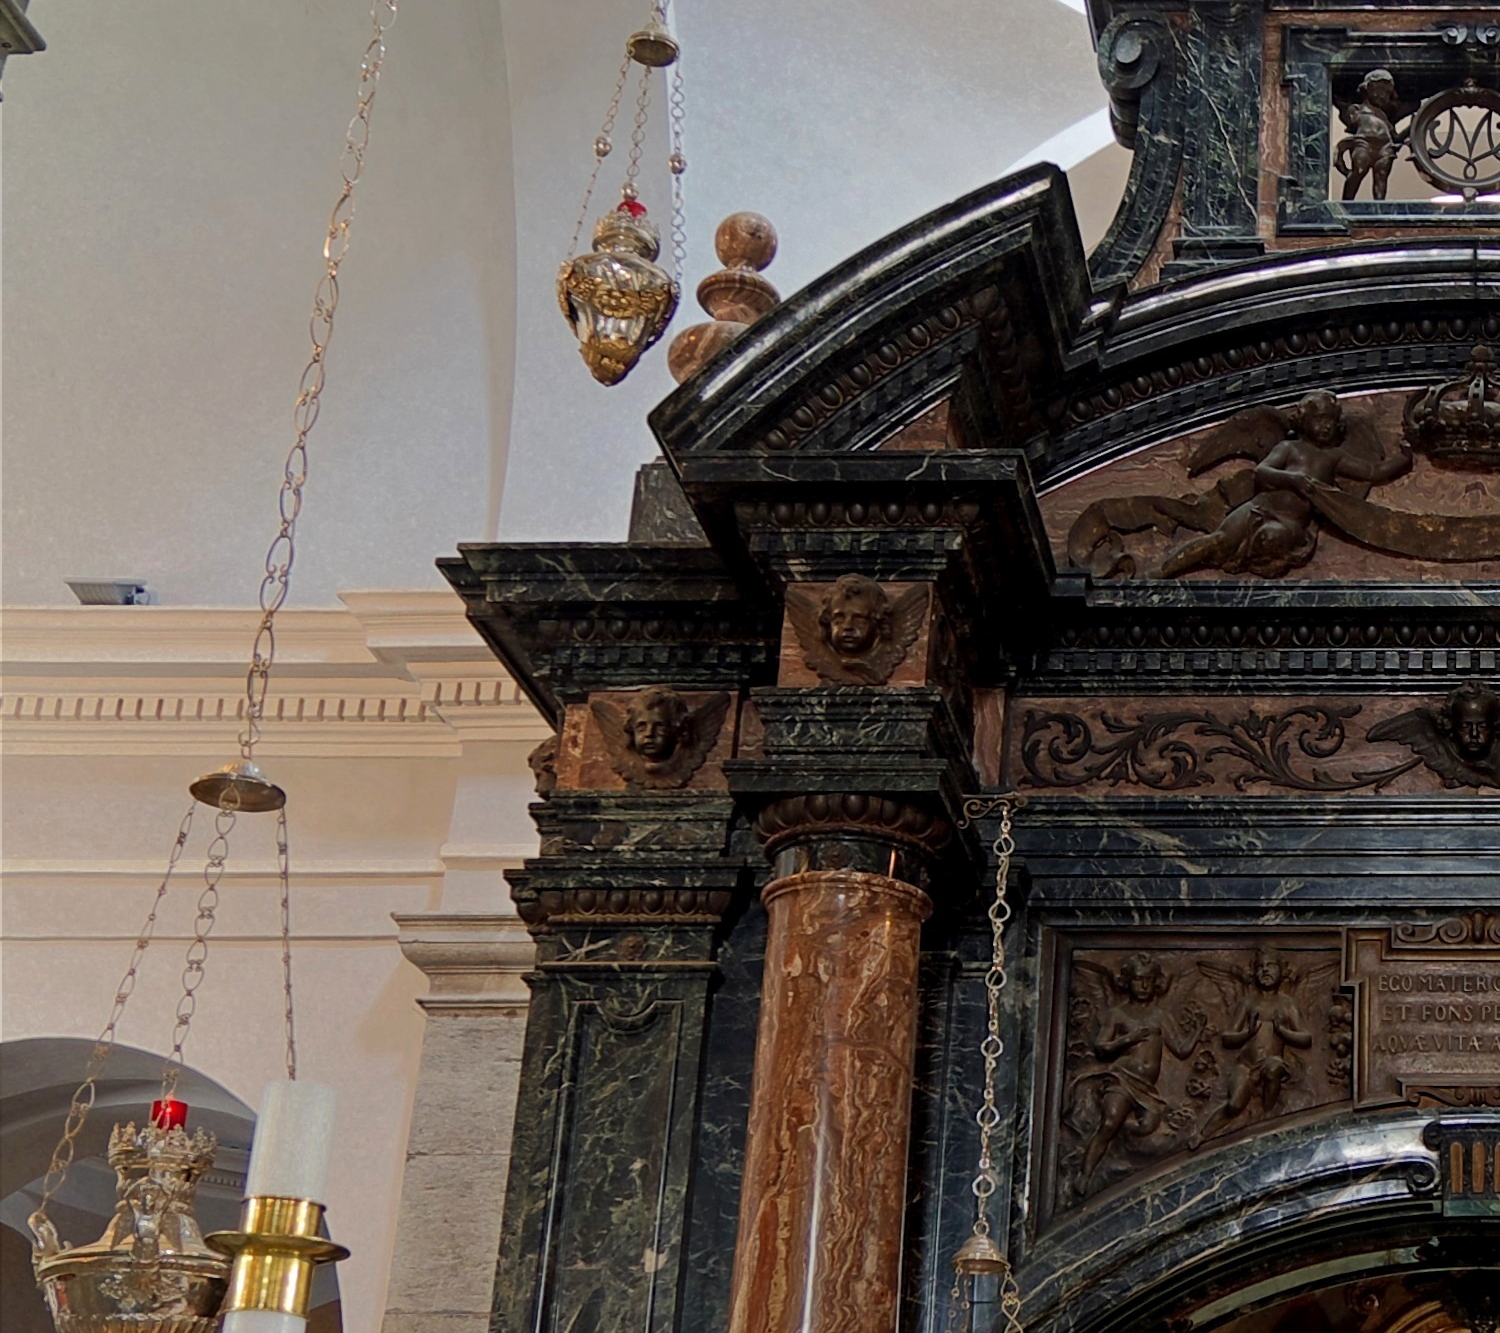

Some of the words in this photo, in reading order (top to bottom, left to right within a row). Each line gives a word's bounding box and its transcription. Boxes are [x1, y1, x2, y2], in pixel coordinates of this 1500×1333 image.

[1378, 974, 1413, 993] EGO
[1418, 974, 1487, 993] MATER
[1381, 1004, 1411, 1022] ET
[1421, 1005, 1473, 1023] FONS
